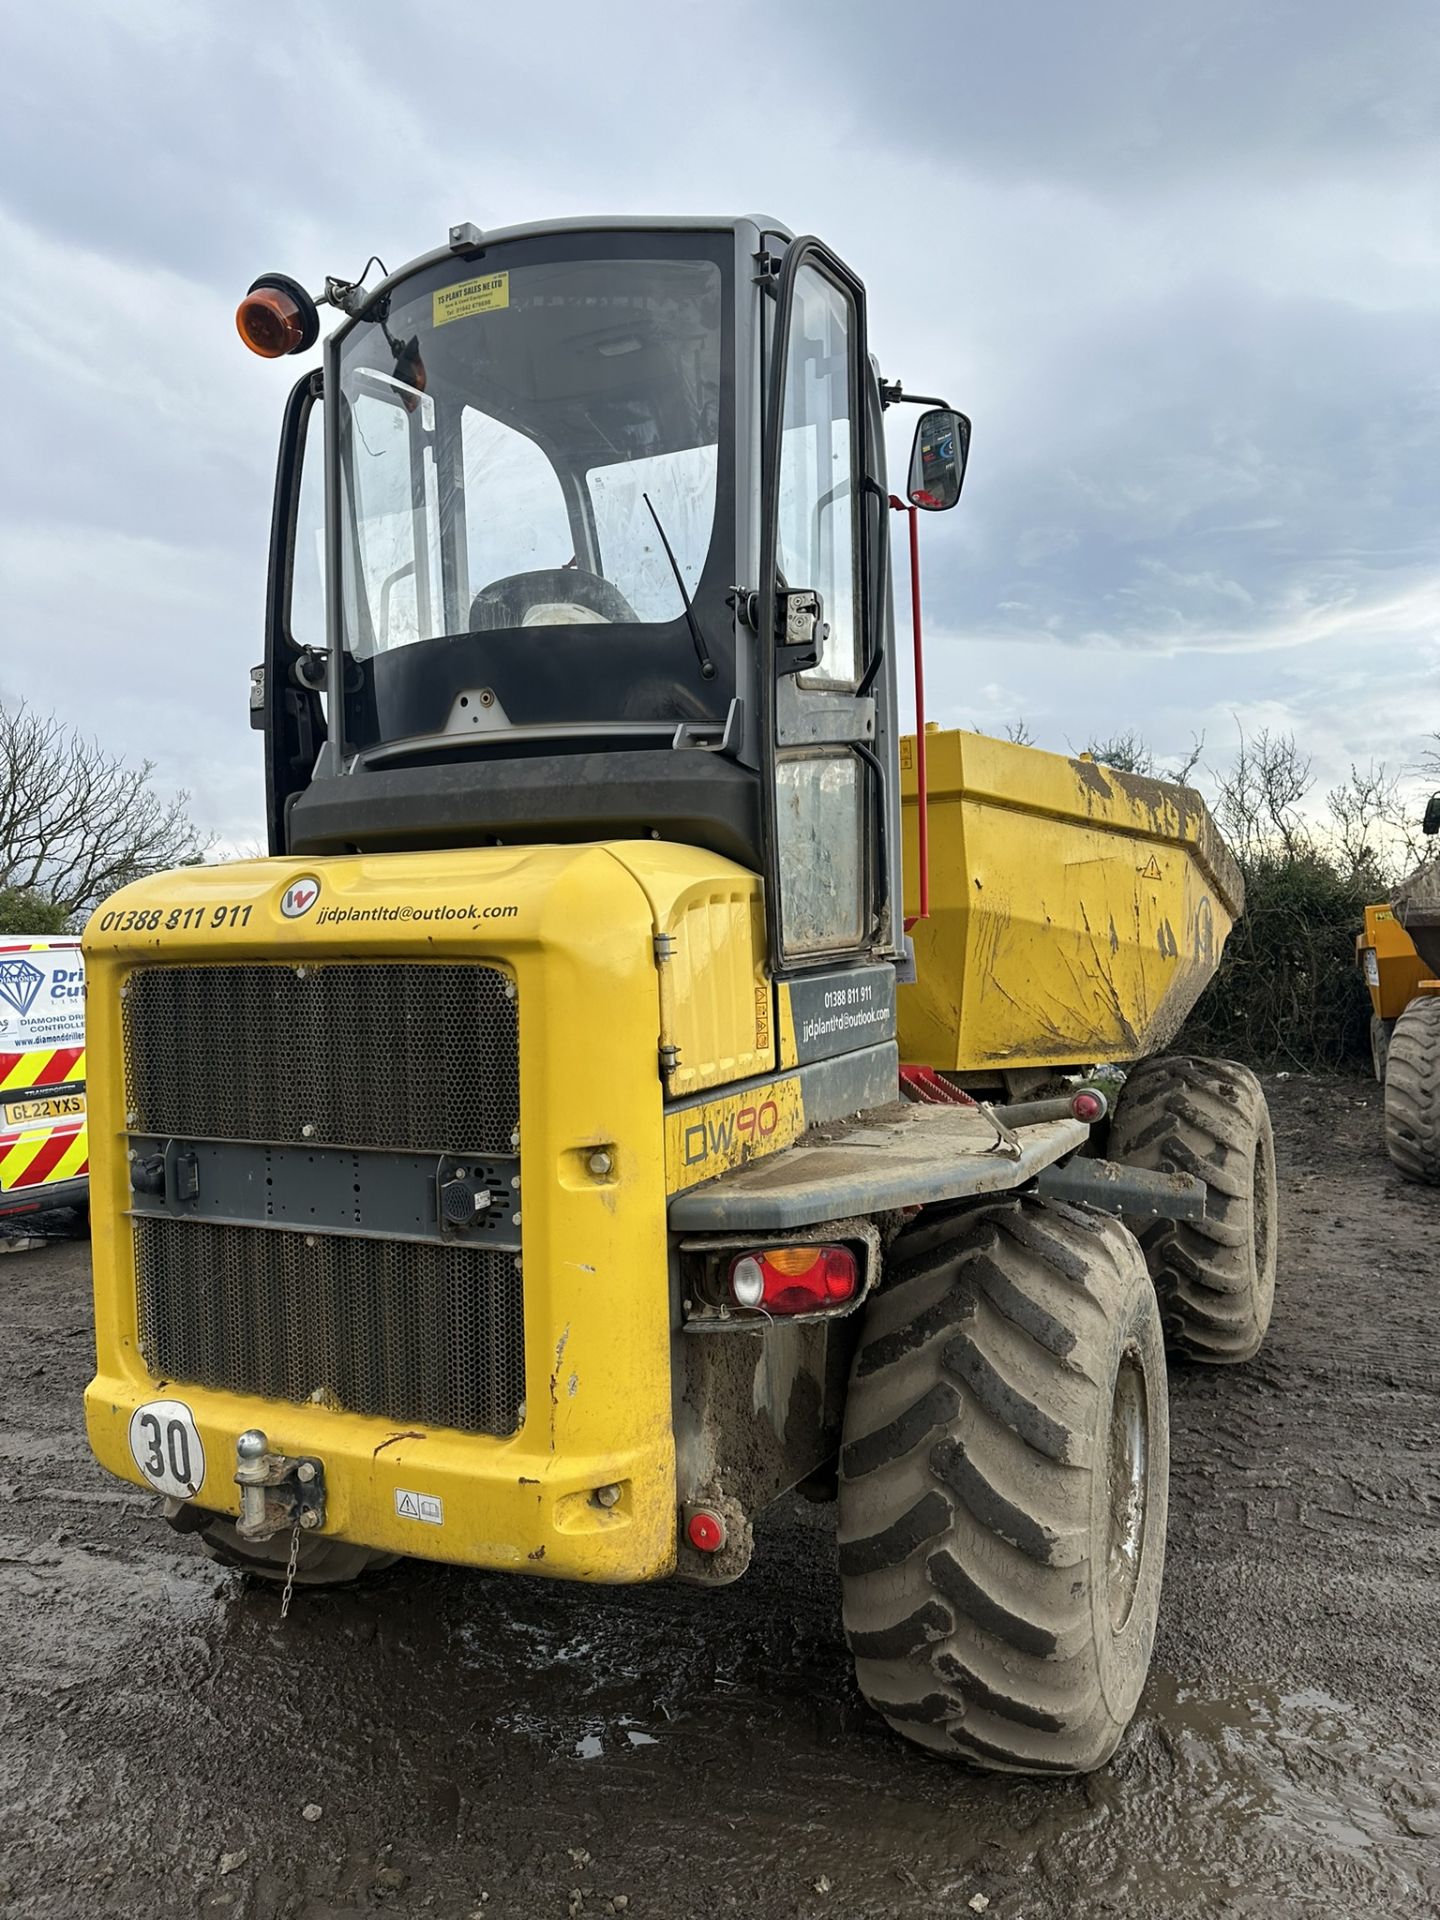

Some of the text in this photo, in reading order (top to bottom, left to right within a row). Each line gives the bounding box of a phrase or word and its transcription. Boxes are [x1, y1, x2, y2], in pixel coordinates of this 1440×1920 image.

[445, 290, 463, 302] PLANT
[464, 284, 482, 297] SALES
[491, 280, 503, 289] LTD
[100, 905, 253, 931] 01388 811 911
[316, 904, 519, 925] jjdplantltd@outlook.com
[824, 985, 872, 1008] 01388 811 911
[20, 1015, 67, 1026] DIAMOND
[803, 1007, 890, 1043] jjdplantltd@outlook.com
[13, 1097, 80, 1120] GL22 YXS
[685, 1101, 778, 1166] DW90
[140, 1413, 192, 1484] 30
